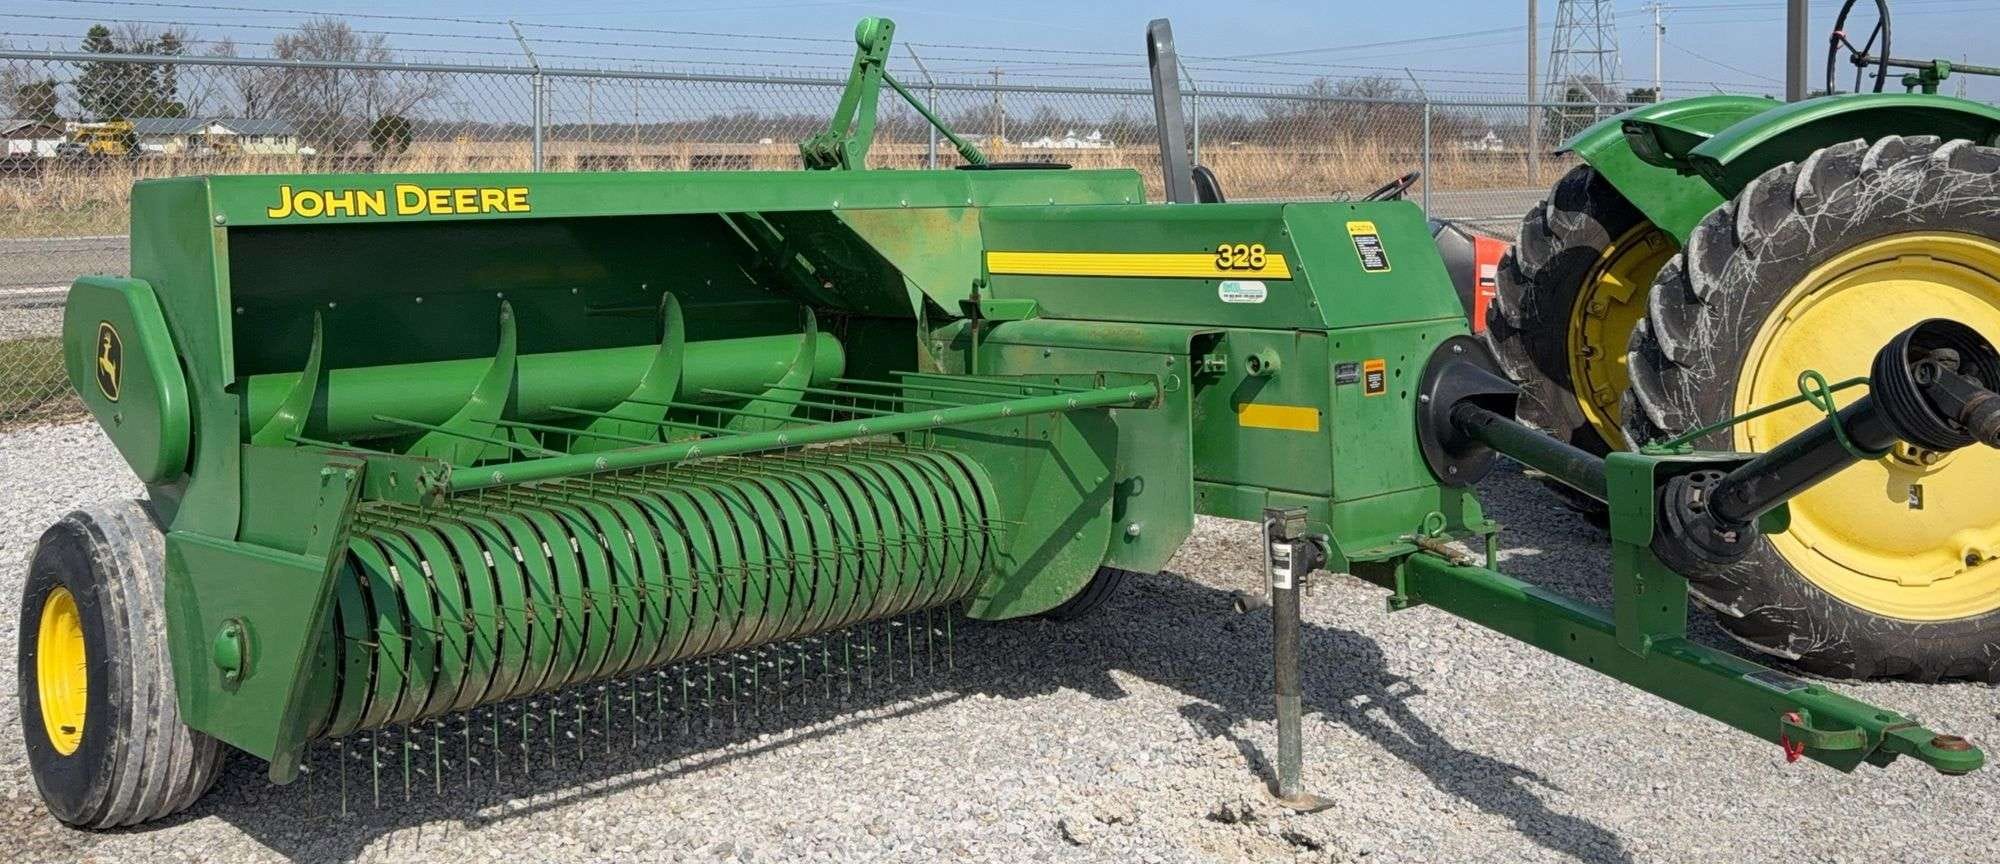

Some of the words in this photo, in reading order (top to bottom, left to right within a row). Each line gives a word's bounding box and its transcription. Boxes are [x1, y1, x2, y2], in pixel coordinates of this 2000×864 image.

[267, 185, 387, 219] JOHN
[394, 183, 531, 216] DEERE
[1216, 243, 1267, 270] 328
